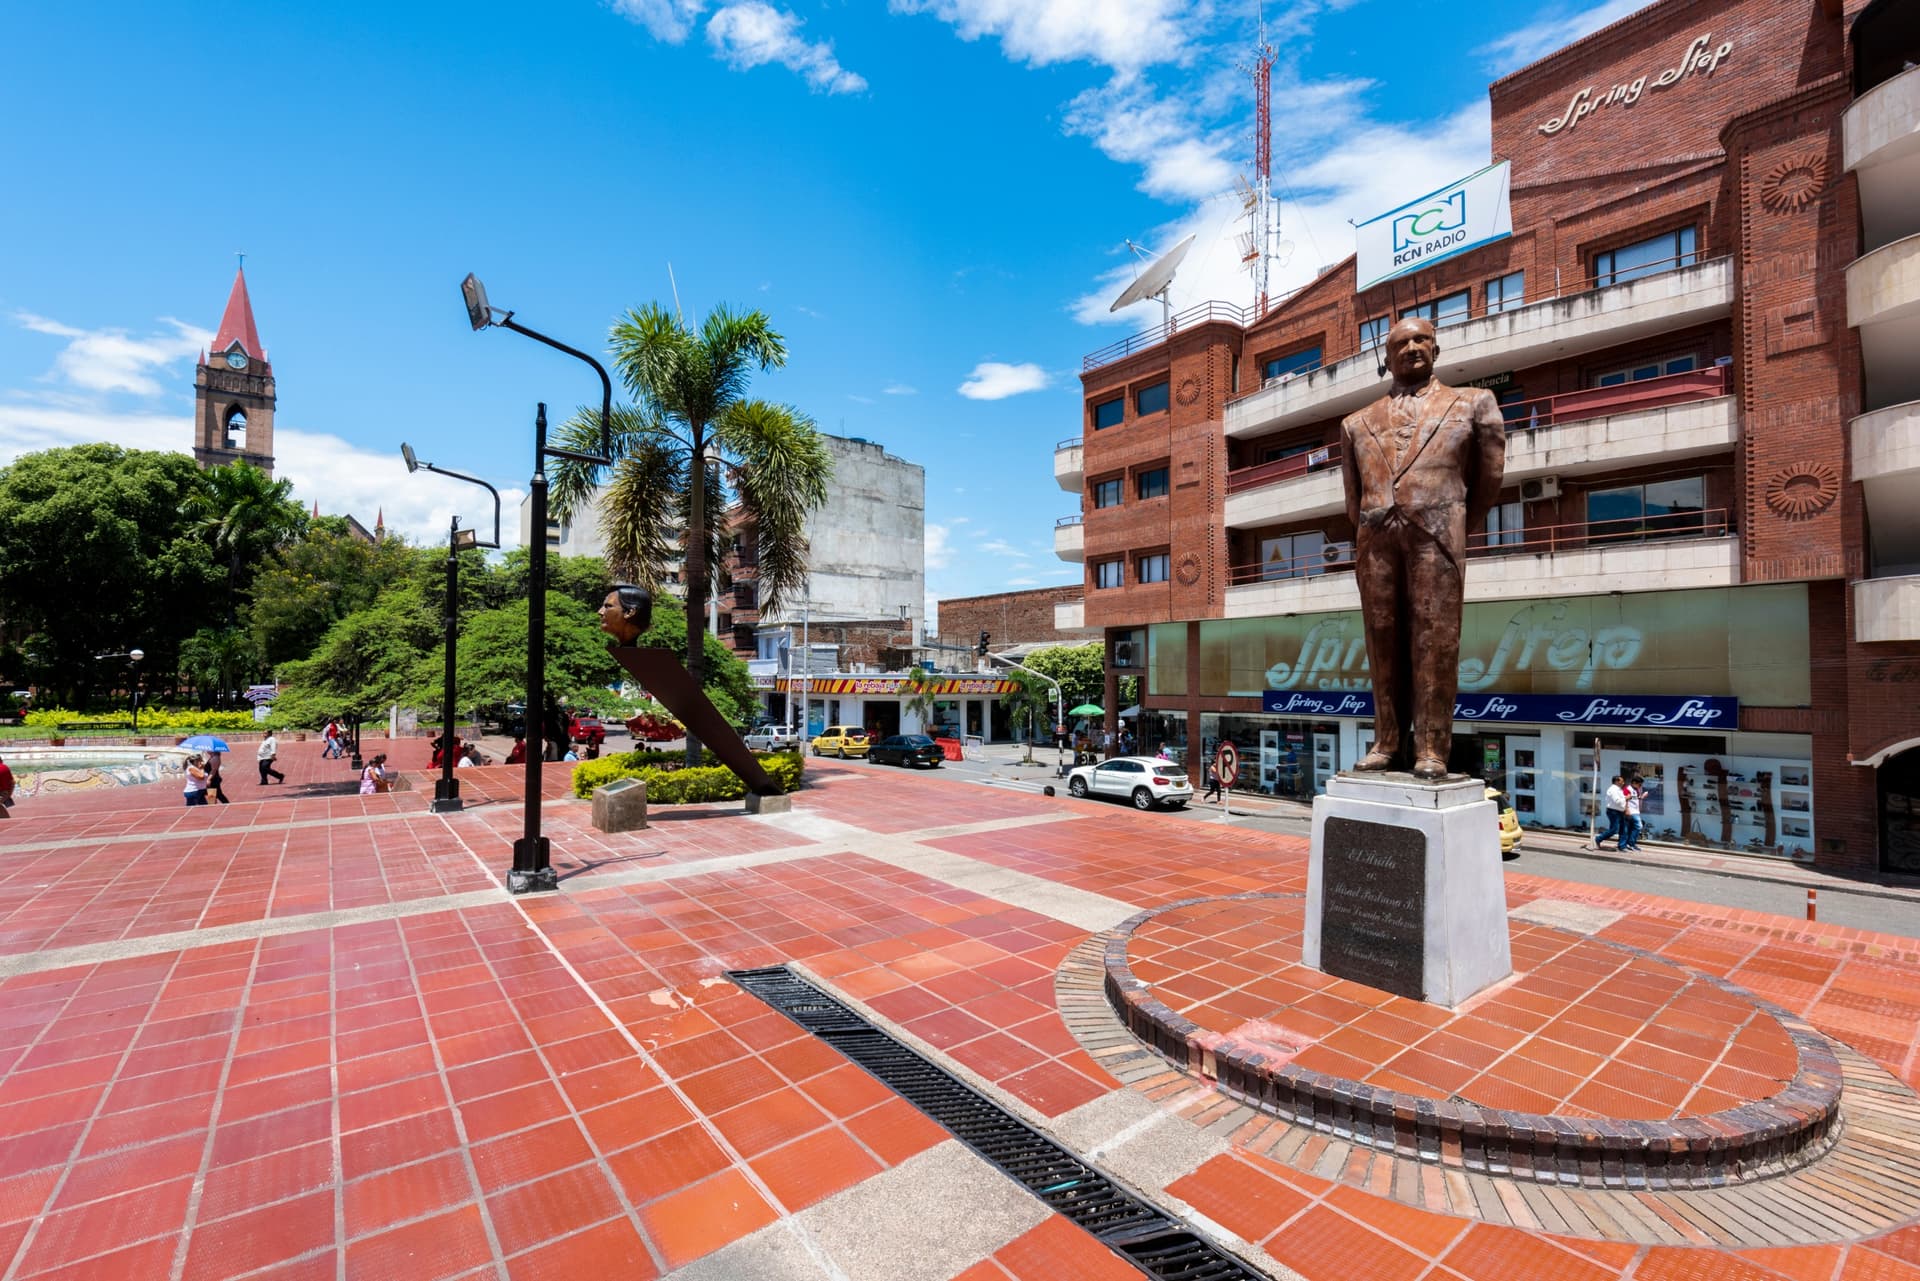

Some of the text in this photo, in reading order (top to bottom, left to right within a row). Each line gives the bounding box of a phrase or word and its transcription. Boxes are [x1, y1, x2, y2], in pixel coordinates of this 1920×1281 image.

[1538, 32, 1734, 133] Spring Step
[1393, 229, 1467, 267] RCN RADIO
[1457, 602, 1642, 690] Step
[1272, 693, 1366, 714] Spring Step
[1460, 697, 1518, 719] Step
[1556, 698, 1722, 724] Spring Step
